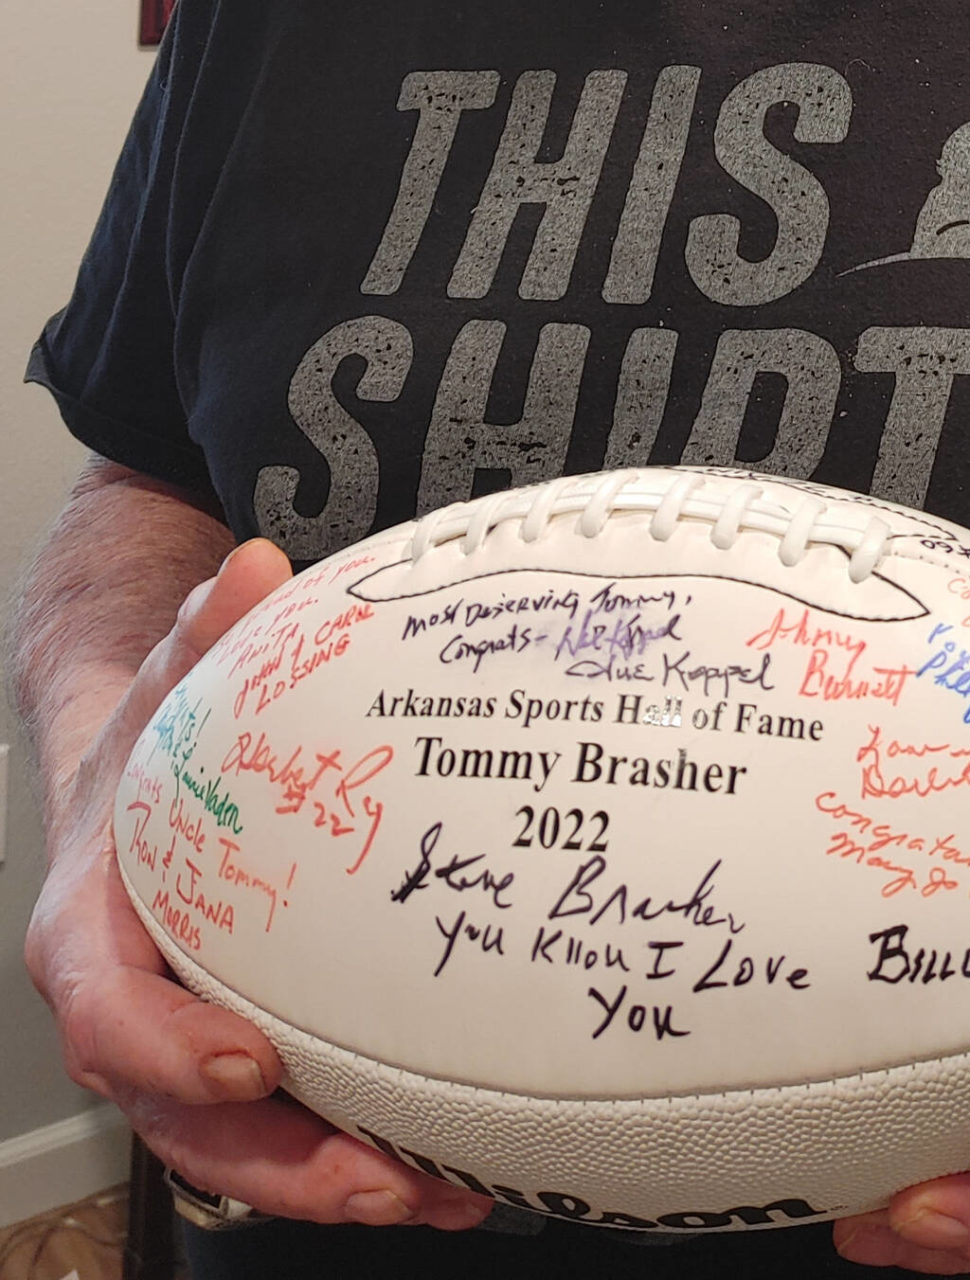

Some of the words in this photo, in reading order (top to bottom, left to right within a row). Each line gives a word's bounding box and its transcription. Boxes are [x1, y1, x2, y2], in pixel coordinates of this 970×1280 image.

[360, 62, 853, 307] THIS
[365, 688, 498, 720] Arkansas
[504, 688, 604, 727] Sports
[612, 693, 682, 728] Hall
[693, 699, 728, 732] of
[732, 703, 825, 742] Fame
[414, 736, 562, 791] Tommy
[569, 740, 748, 795] Brasher
[512, 805, 611, 852] 2022
[645, 940, 685, 980] I
[692, 938, 812, 993] Love
[588, 985, 692, 1040] You
